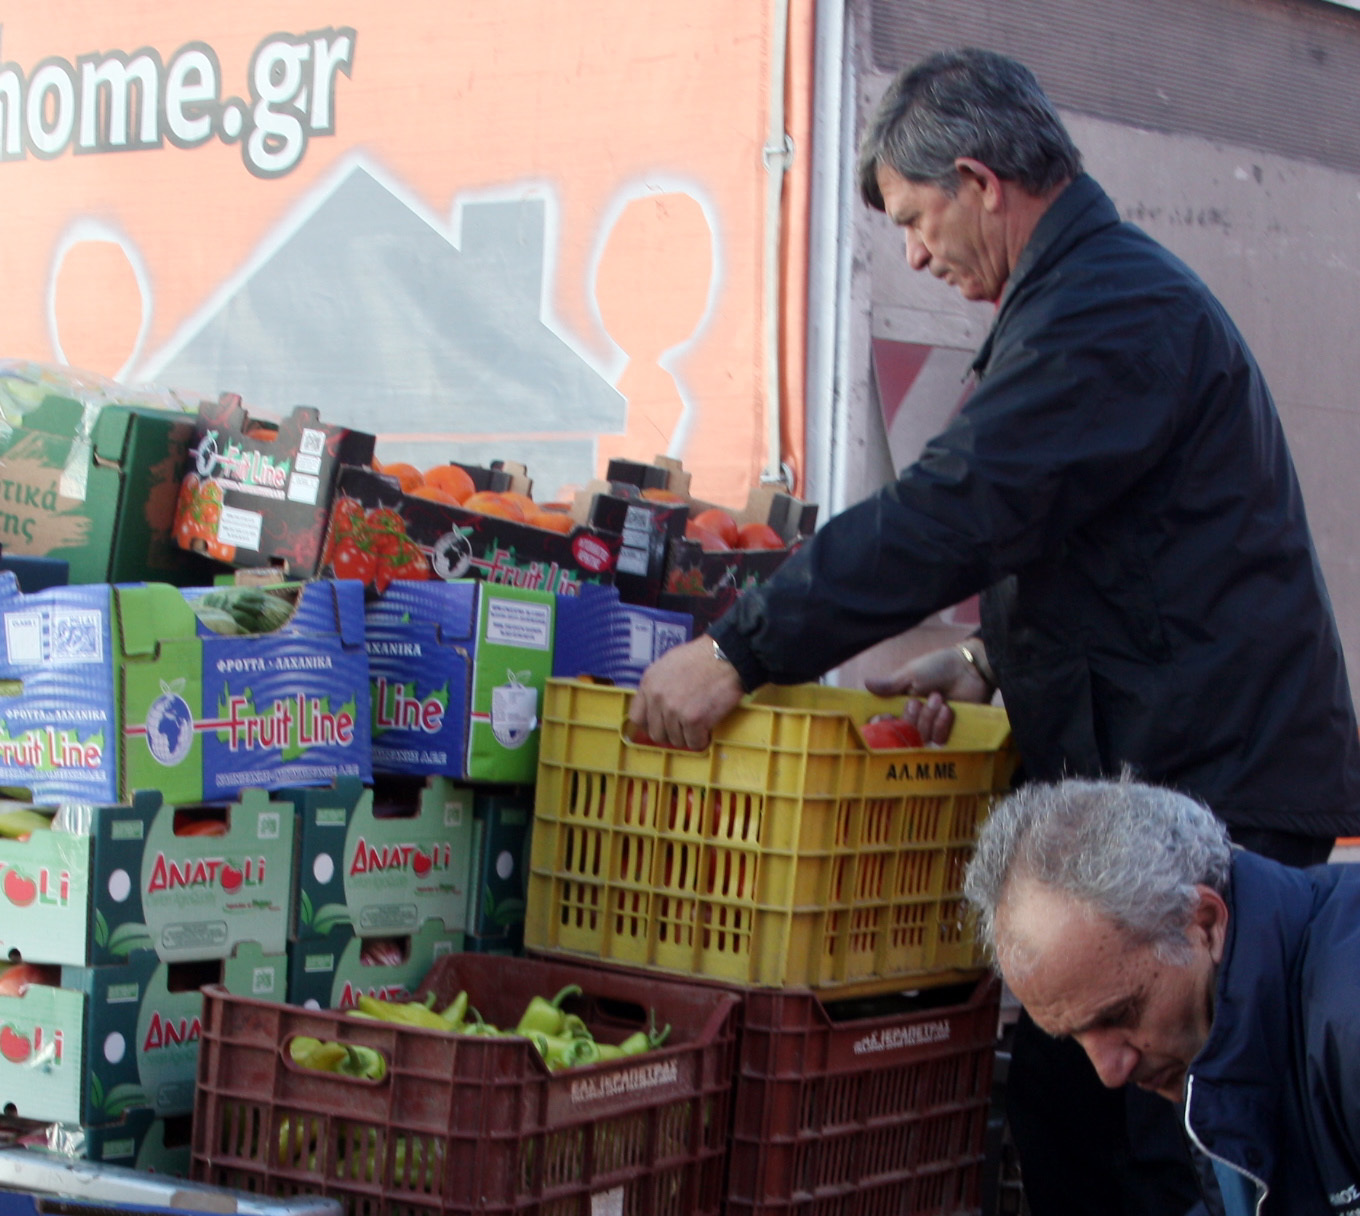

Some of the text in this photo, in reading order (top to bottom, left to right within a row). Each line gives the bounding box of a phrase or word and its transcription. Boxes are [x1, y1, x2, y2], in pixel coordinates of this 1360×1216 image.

[251, 449, 288, 489] Line
[488, 548, 544, 592] Fruit
[546, 561, 578, 596] Lin
[215, 655, 333, 673] ΦΡΟΥΤΑ ΛΑΧΑΝΙΚΑ
[228, 691, 354, 752] Fruit Line
[376, 676, 446, 734] Line
[46, 725, 103, 769] Line
